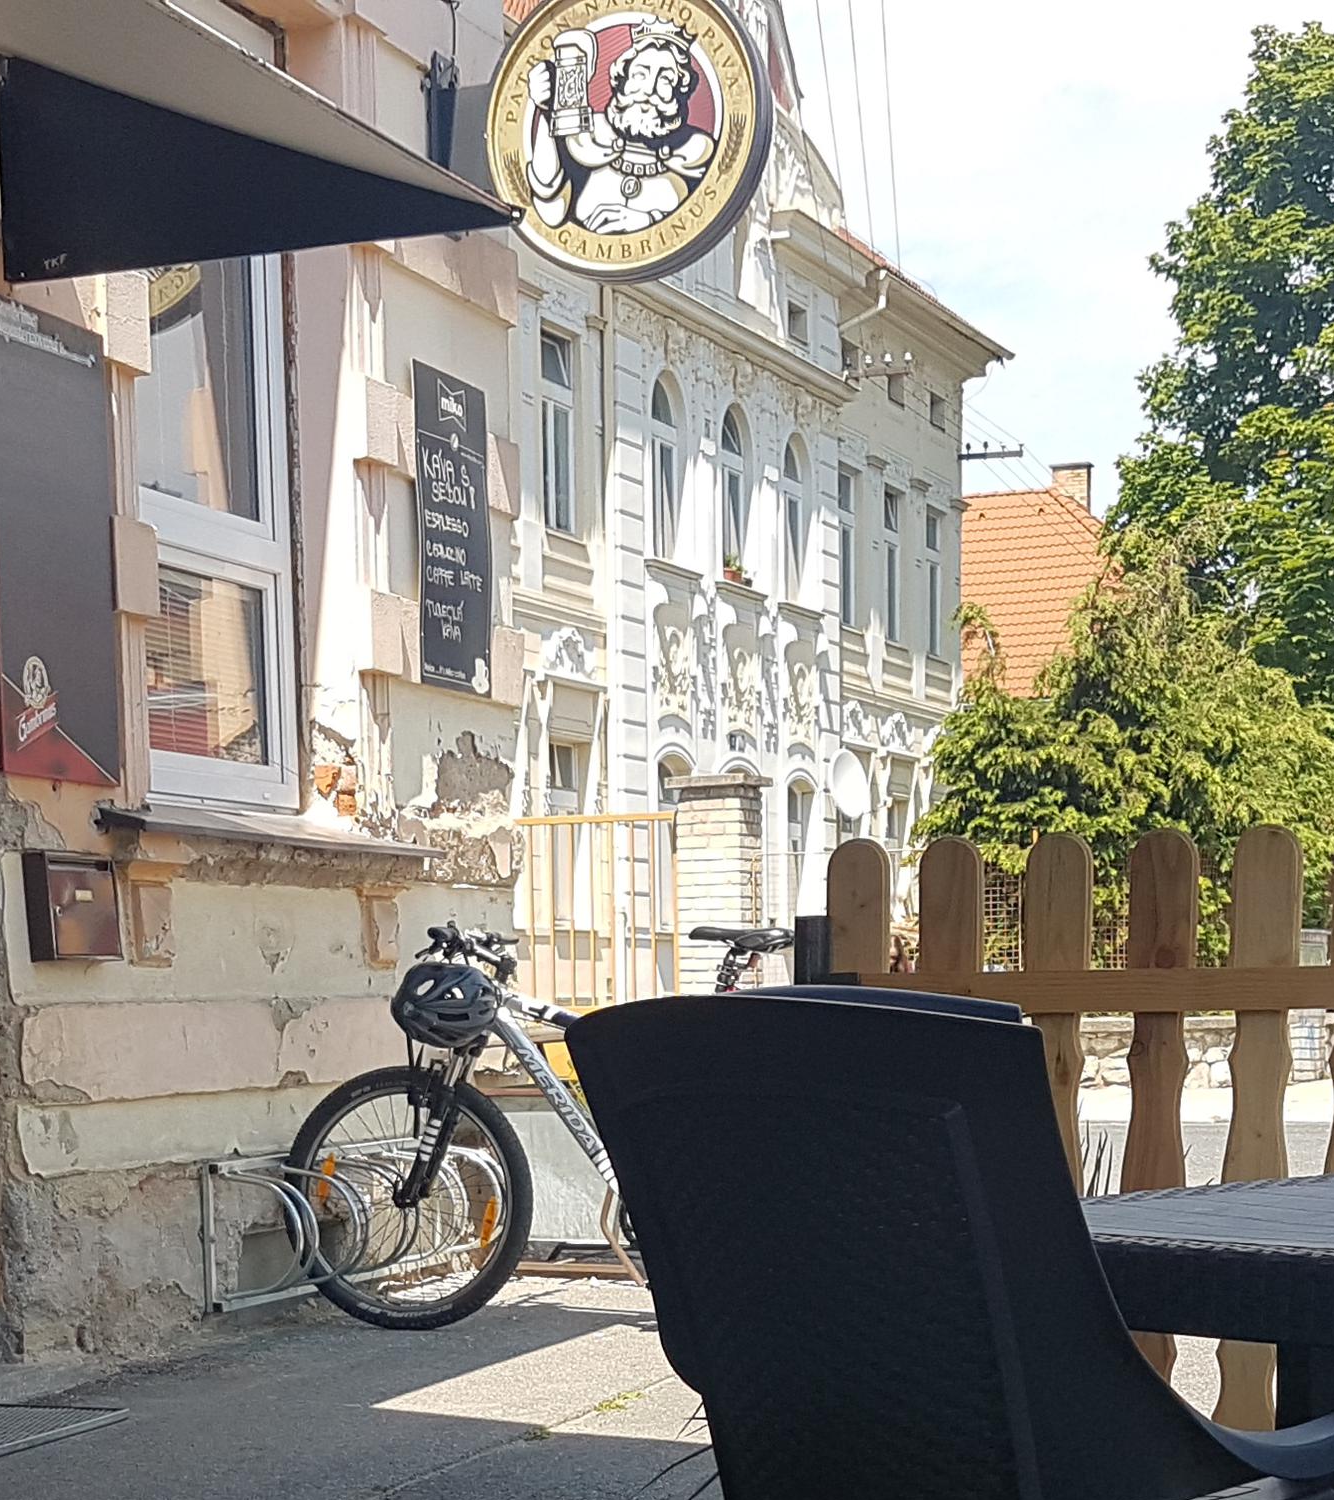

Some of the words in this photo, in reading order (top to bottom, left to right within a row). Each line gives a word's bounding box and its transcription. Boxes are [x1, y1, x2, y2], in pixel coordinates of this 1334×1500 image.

[506, 17, 573, 124] PATRON
[702, 26, 740, 90] PIVA
[557, 185, 718, 260] GAMBRINUS
[461, 464, 470, 487] S
[517, 1048, 597, 1152] MERIDA
